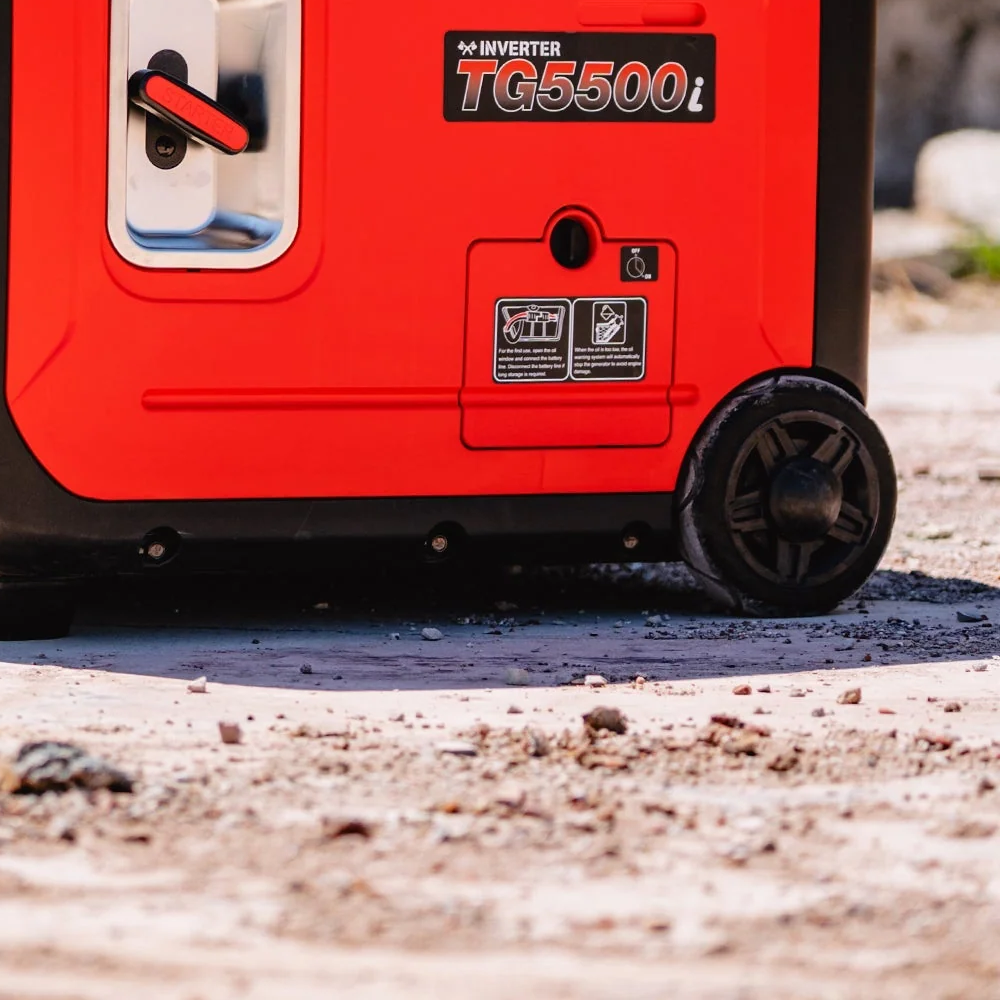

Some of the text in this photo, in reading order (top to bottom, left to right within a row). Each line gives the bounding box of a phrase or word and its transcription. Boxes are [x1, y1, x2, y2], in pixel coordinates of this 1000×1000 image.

[480, 40, 561, 57] INVERTER
[456, 58, 704, 113] TG5500i
[164, 87, 237, 136] STARTER
